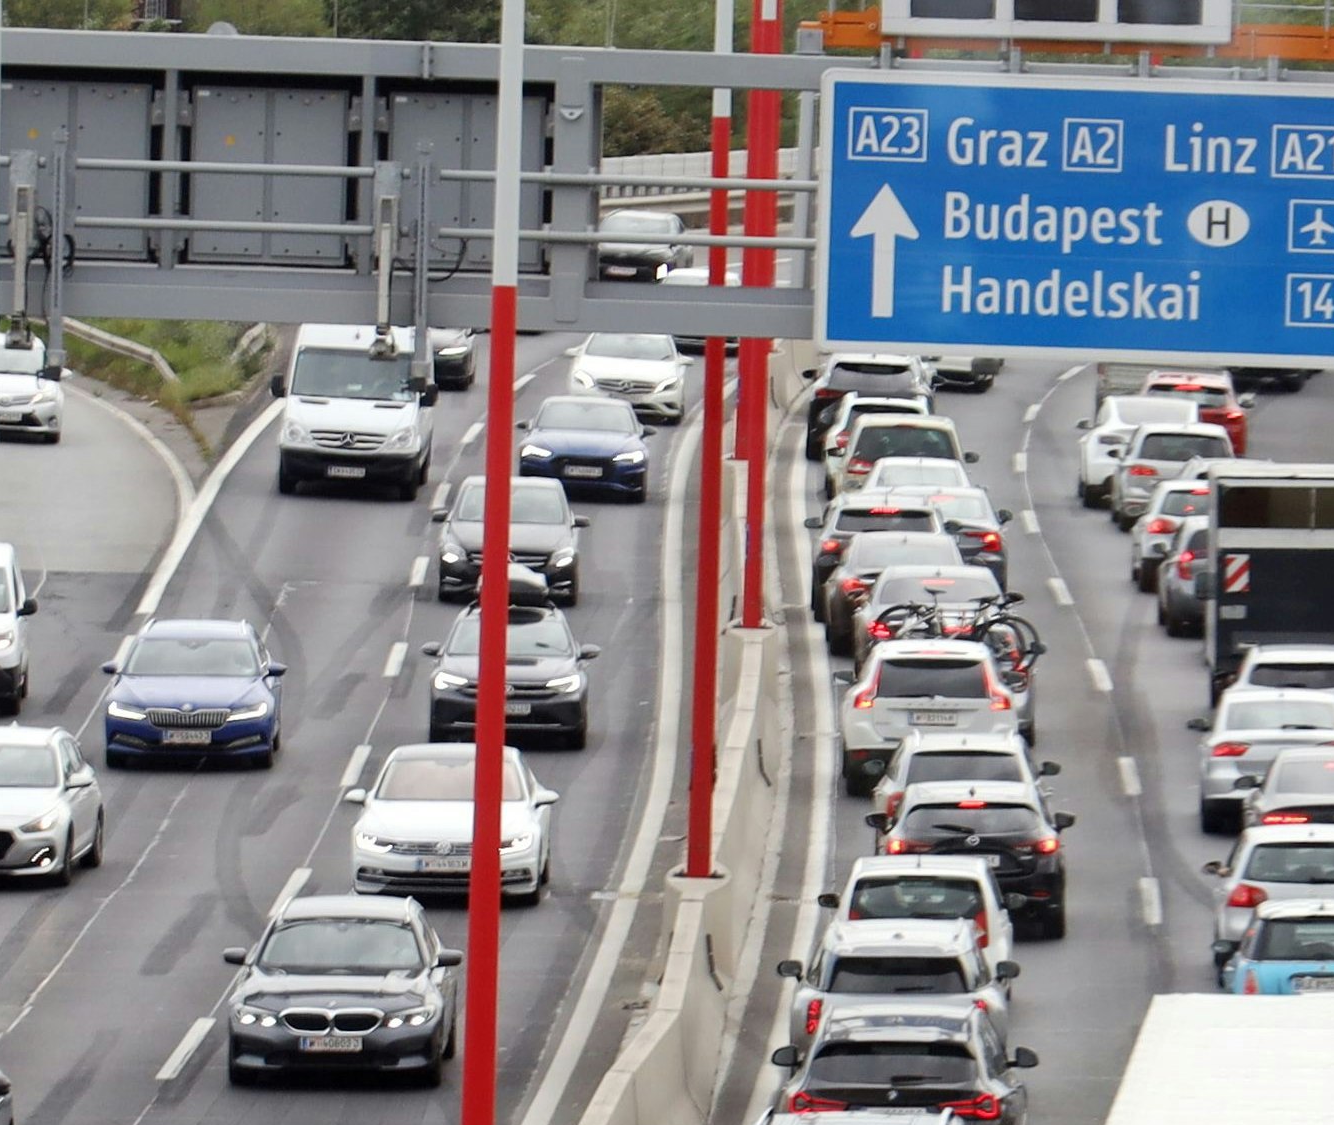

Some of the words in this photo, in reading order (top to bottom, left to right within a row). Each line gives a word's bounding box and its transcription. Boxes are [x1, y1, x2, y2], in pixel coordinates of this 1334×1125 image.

[854, 115, 921, 155] A23
[947, 116, 1049, 168] Graz
[1070, 126, 1115, 165] A2
[1164, 122, 1258, 174] Linz
[943, 191, 1164, 254] Budapest
[1205, 206, 1231, 240] H
[940, 264, 1202, 321] Handelskai
